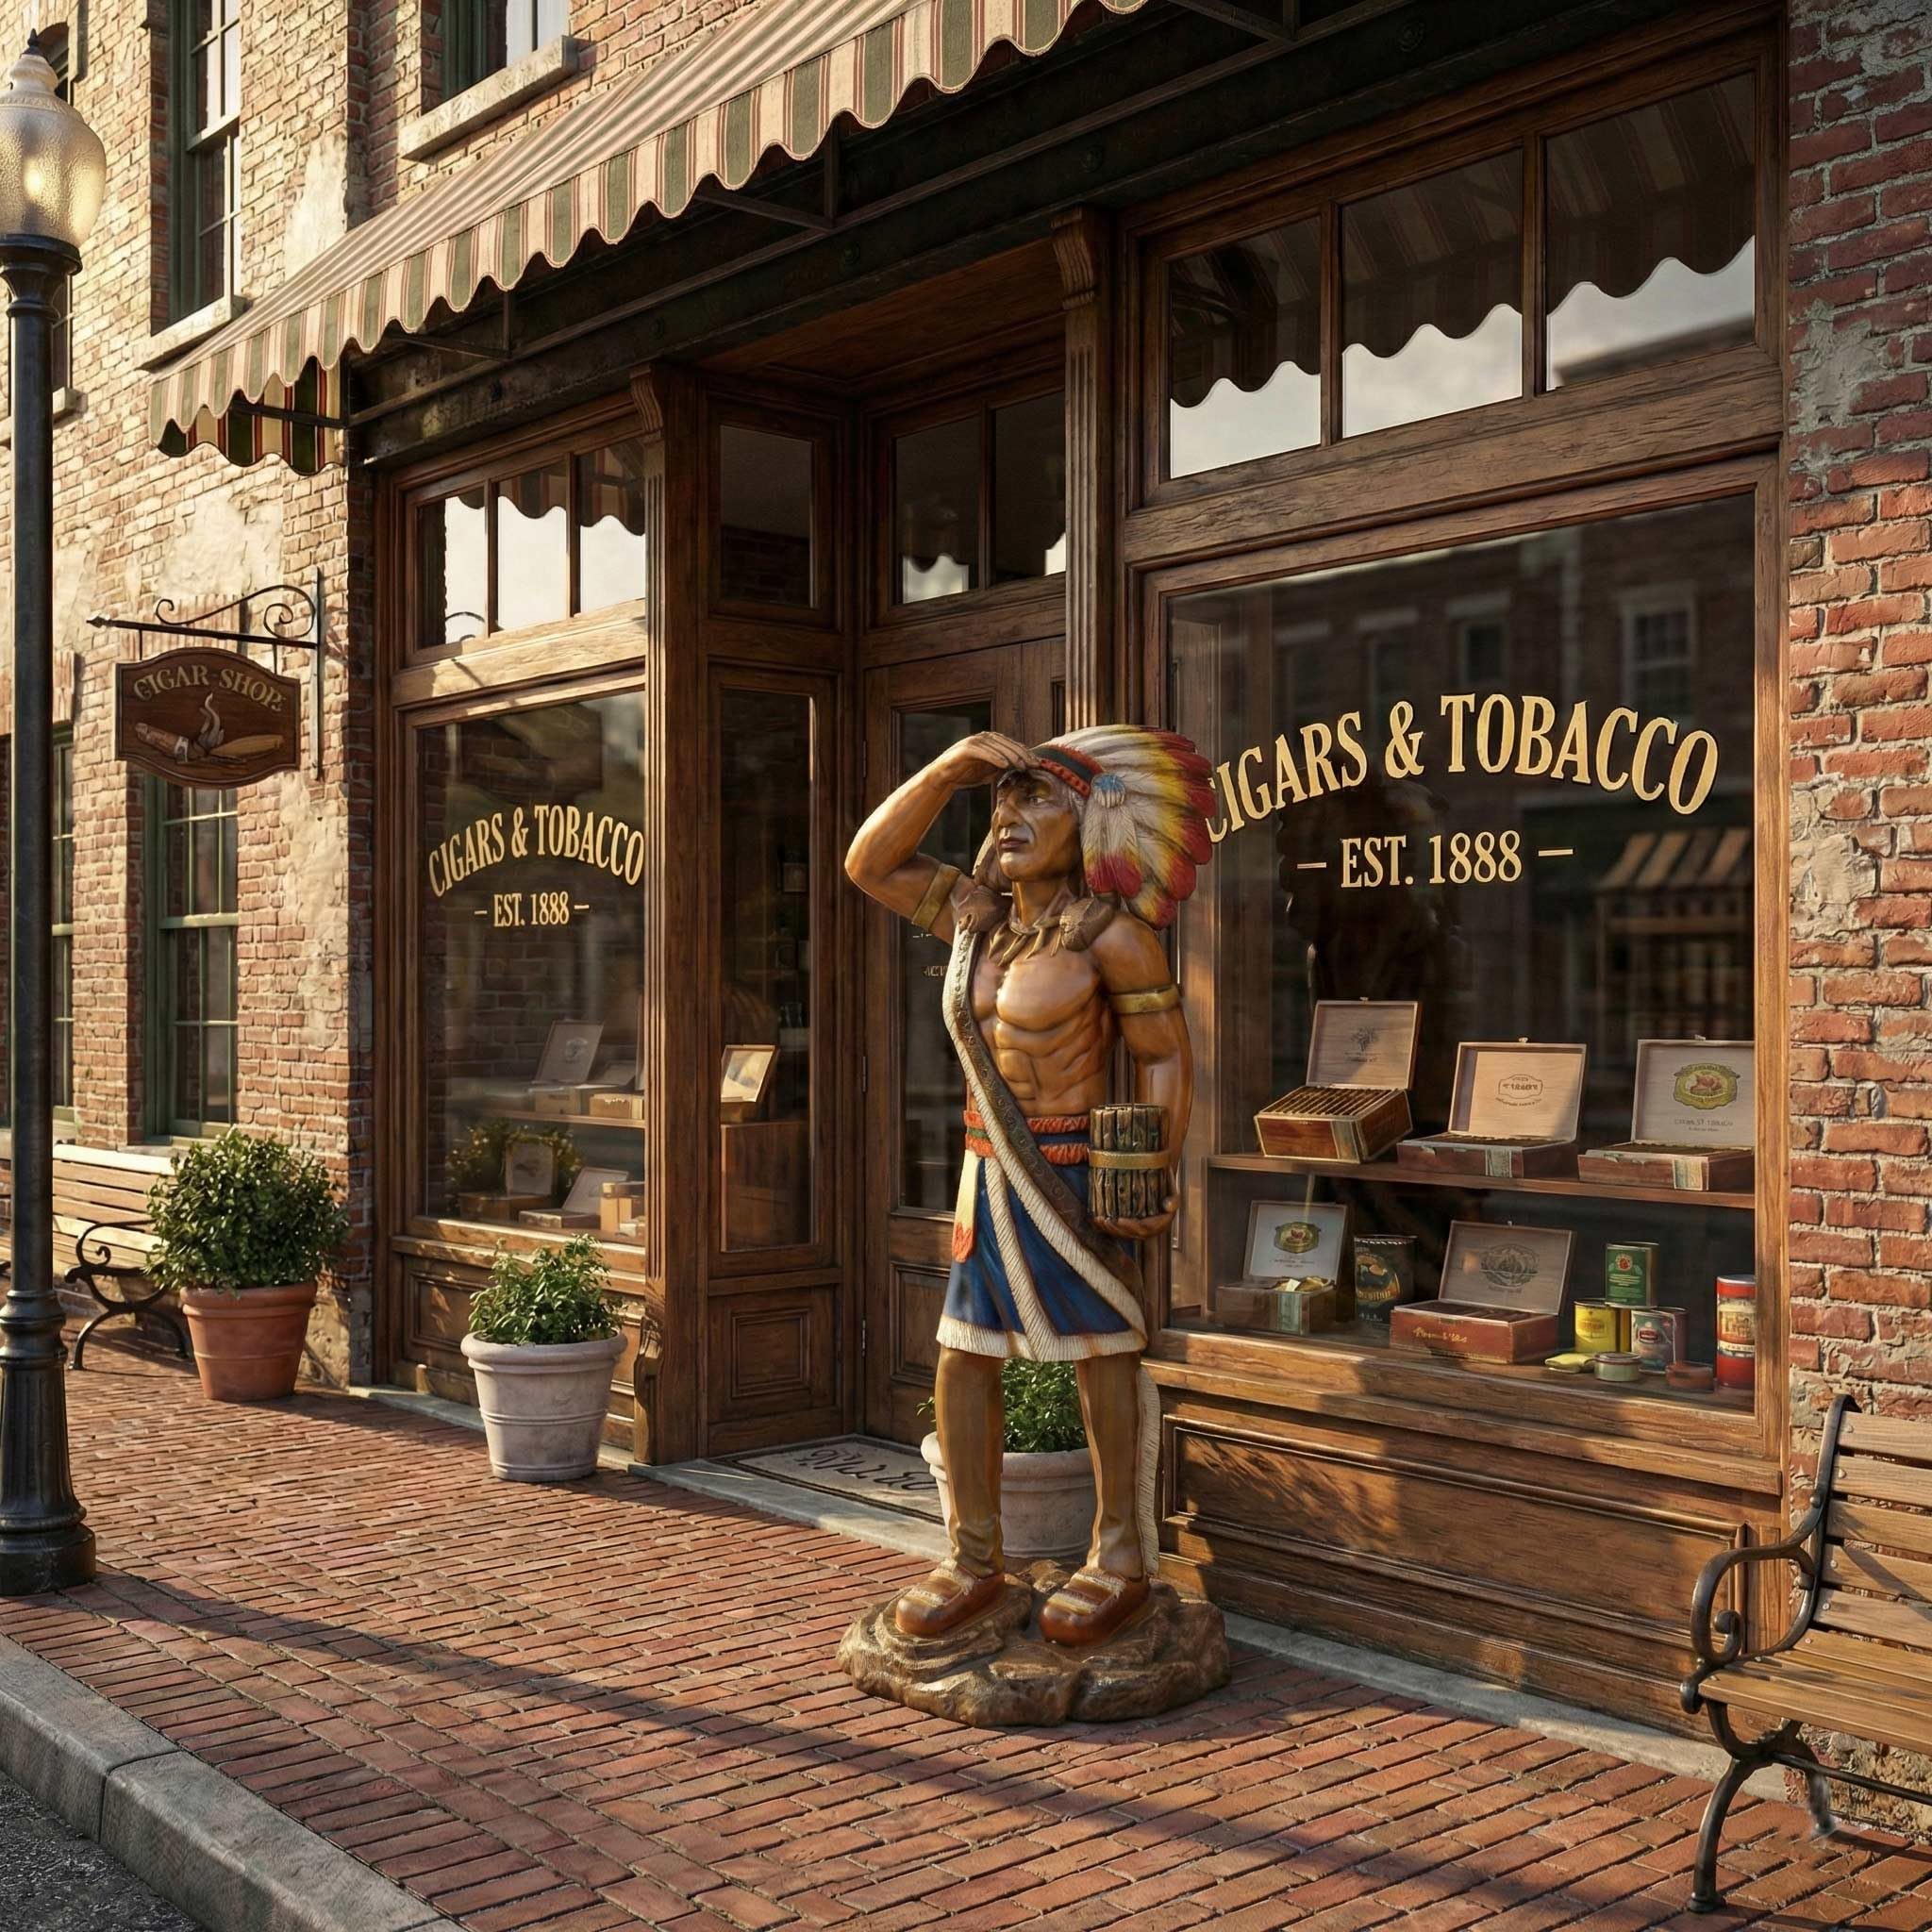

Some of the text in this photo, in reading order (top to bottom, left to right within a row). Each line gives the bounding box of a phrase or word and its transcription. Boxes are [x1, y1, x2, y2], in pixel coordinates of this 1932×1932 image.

[1385, 700, 1425, 779] &
[1440, 693, 1719, 815] TOBACCO
[428, 804, 645, 897] CIGARS & TOBACCO
[1341, 830, 1523, 888] EST. 1888
[493, 891, 570, 927] EST. 1888
